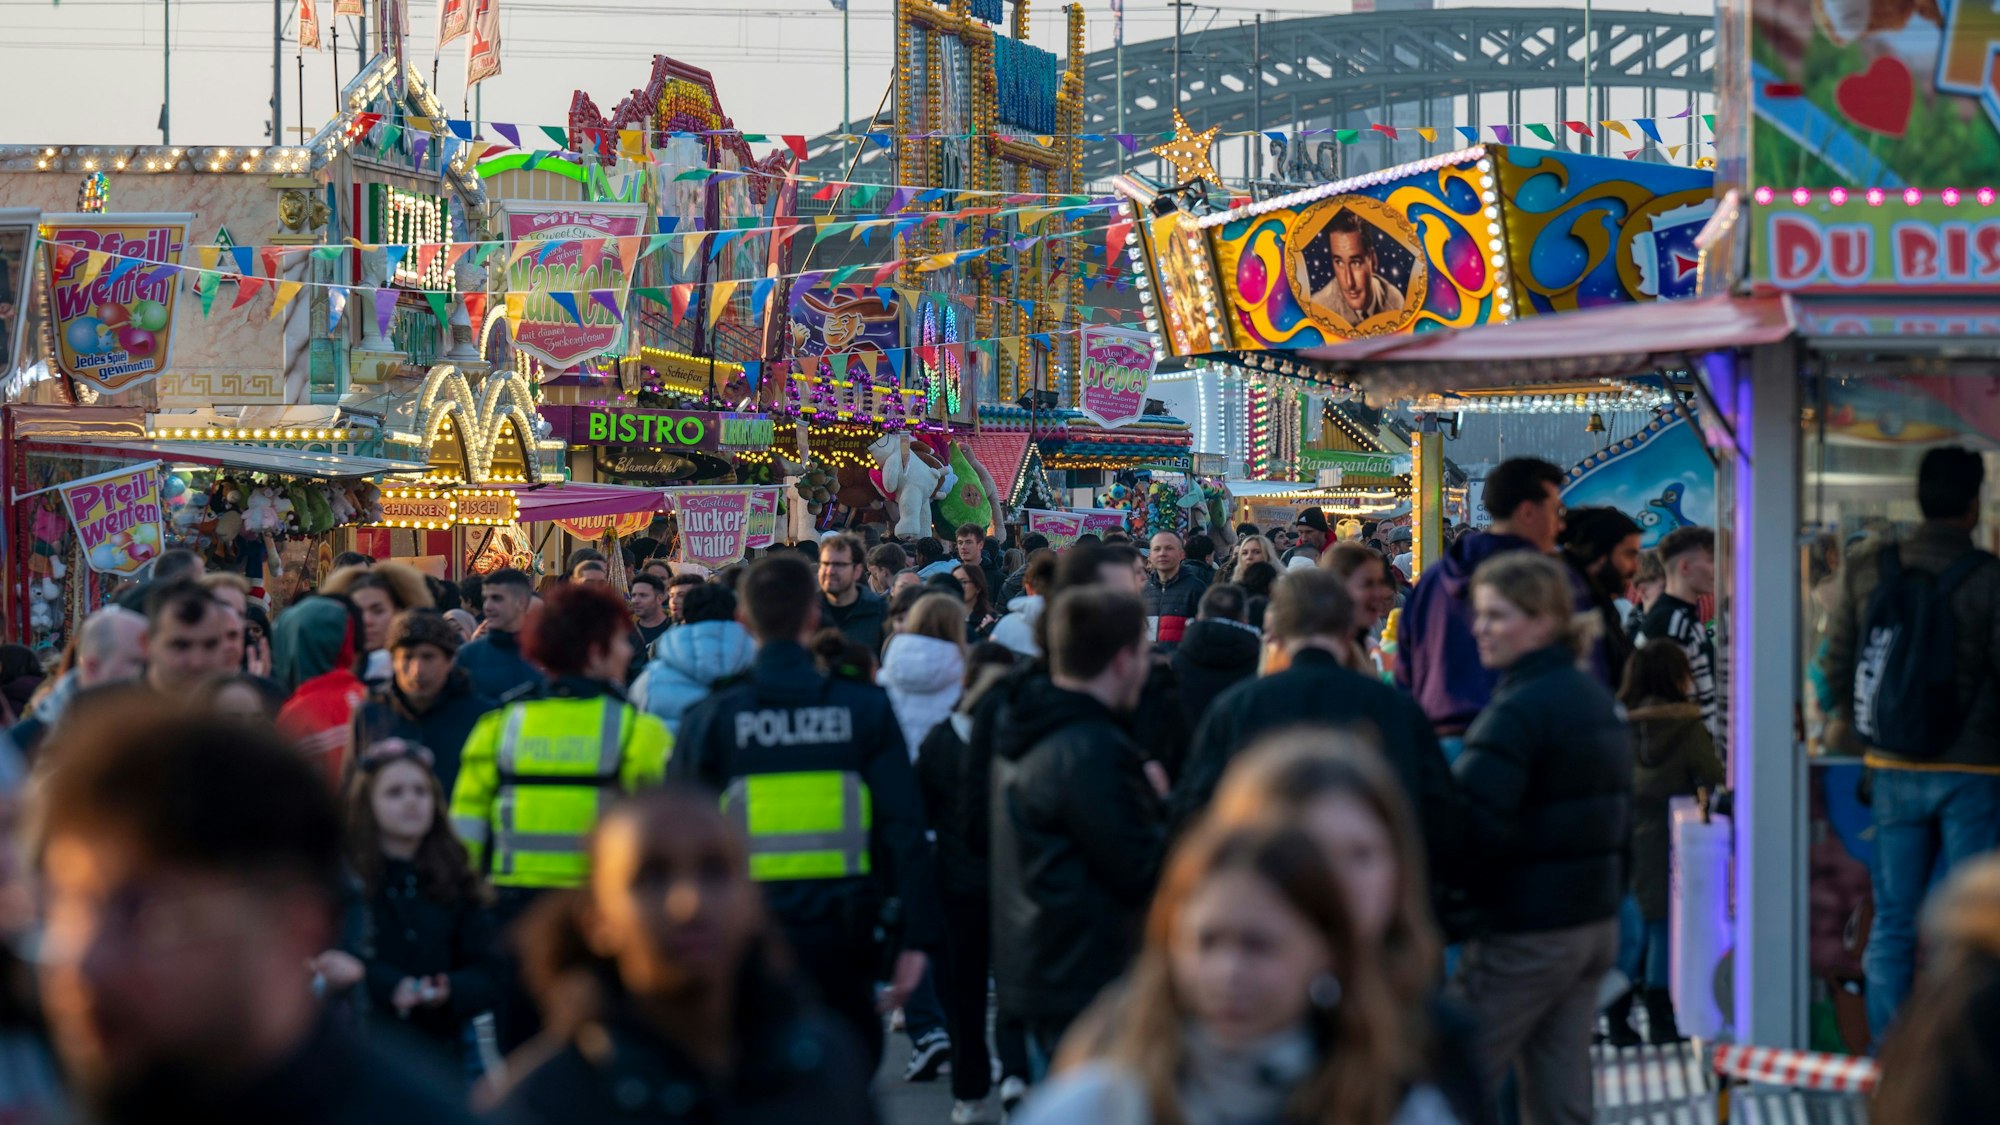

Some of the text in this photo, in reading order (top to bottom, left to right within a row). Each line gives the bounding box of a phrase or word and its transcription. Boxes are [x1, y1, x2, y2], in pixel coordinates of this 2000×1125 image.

[532, 211, 611, 229] MILZ
[55, 228, 183, 279] Pfeil-
[1768, 211, 1873, 287] DU
[56, 266, 170, 322] werfen
[74, 351, 128, 369] Jedes Spiel
[98, 359, 154, 380] gewinnt!!!
[665, 365, 703, 383] Schießen
[1083, 357, 1151, 394] Crêpes
[589, 412, 705, 446] BISTRO
[615, 456, 682, 476] Blumenkohl
[1299, 456, 1391, 474] Parmesanlaib
[70, 471, 157, 522] Pfeil-
[457, 501, 499, 515] FISCH
[383, 503, 447, 517] CHINKEN
[682, 508, 748, 532] Zucker-
[80, 500, 159, 551] werfen
[689, 532, 735, 558] watte
[735, 706, 852, 749] POLIZEI
